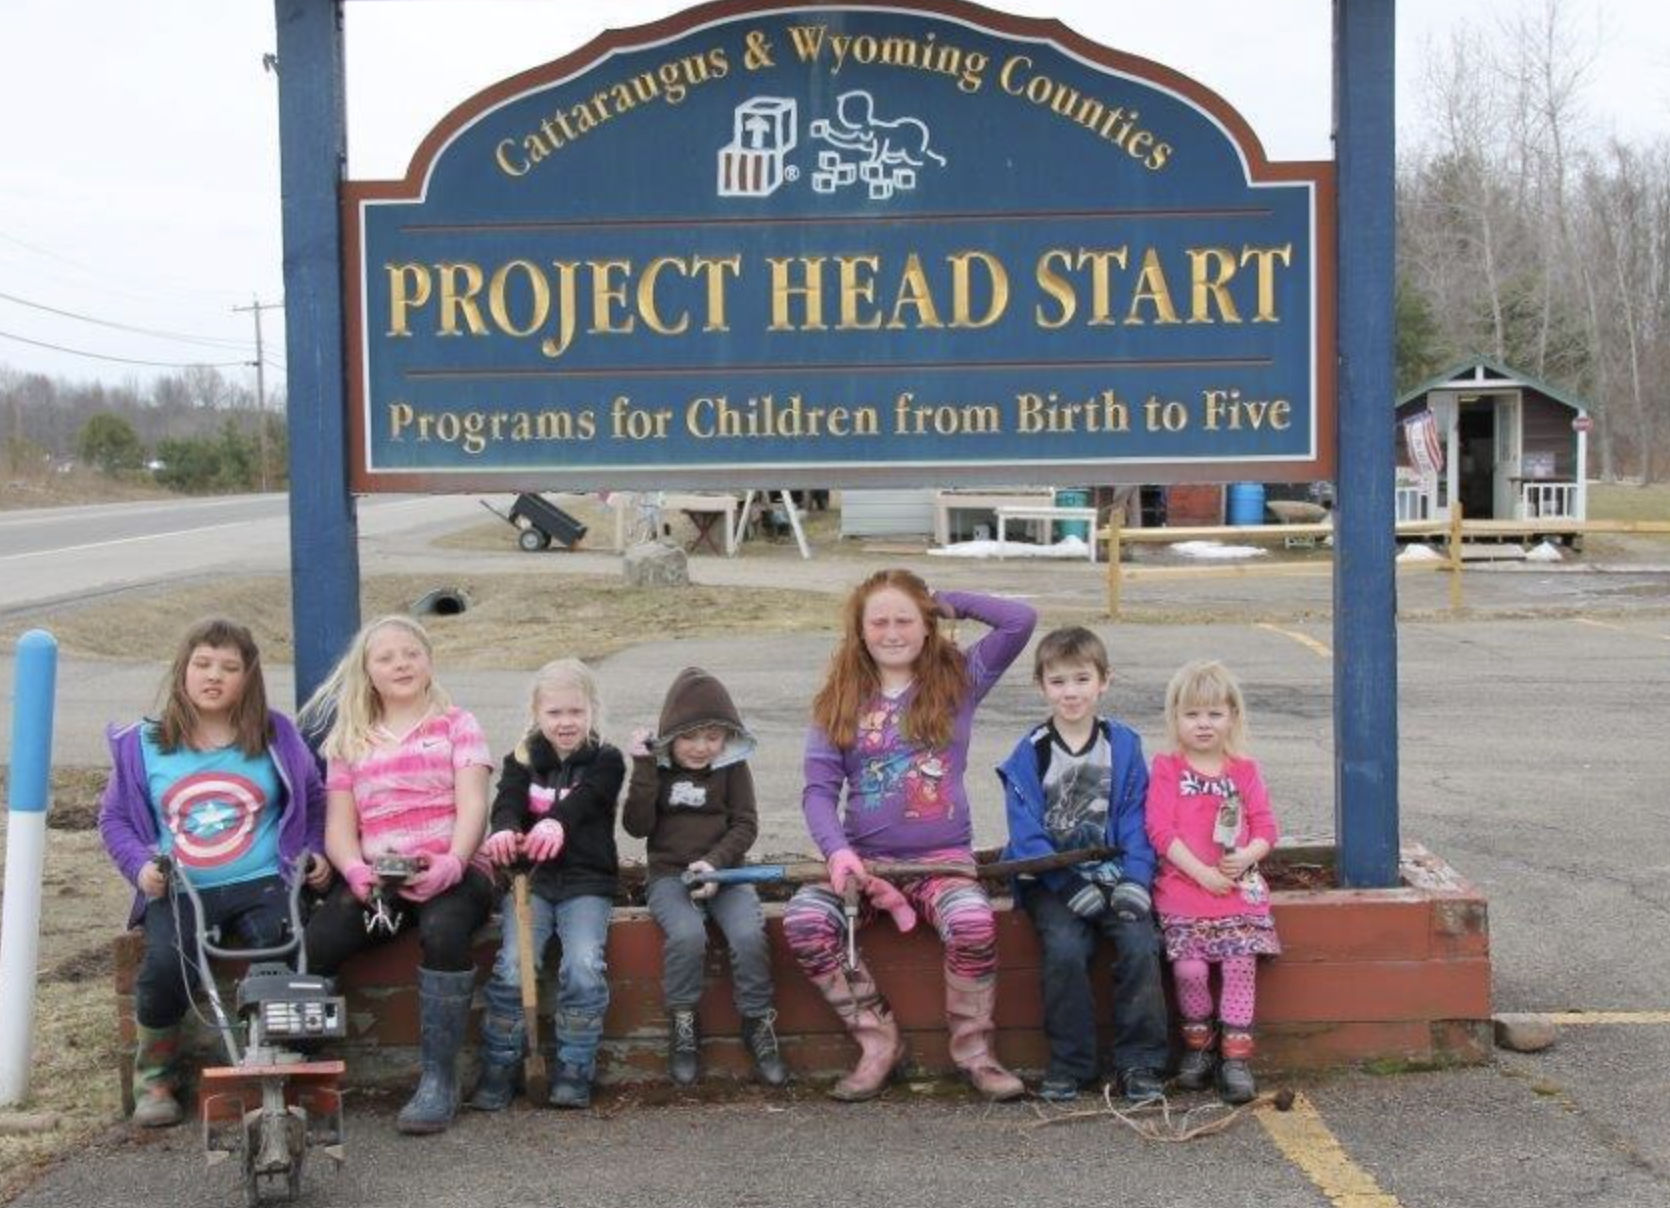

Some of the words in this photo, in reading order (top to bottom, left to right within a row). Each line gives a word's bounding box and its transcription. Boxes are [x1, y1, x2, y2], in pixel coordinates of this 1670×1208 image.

[495, 46, 729, 177] Cattaraugus
[743, 30, 775, 71] &
[788, 24, 988, 92] Wyoming
[1000, 54, 1173, 171] Counties
[384, 255, 742, 358] PROJECT
[765, 252, 1010, 331] HEAD
[1035, 243, 1293, 329] START
[388, 403, 597, 454] Programs
[611, 396, 674, 440] for
[686, 394, 880, 439] Children
[894, 393, 1000, 436] from
[1016, 390, 1130, 433] Birth
[1144, 396, 1189, 431] to
[1203, 390, 1292, 431] Five
